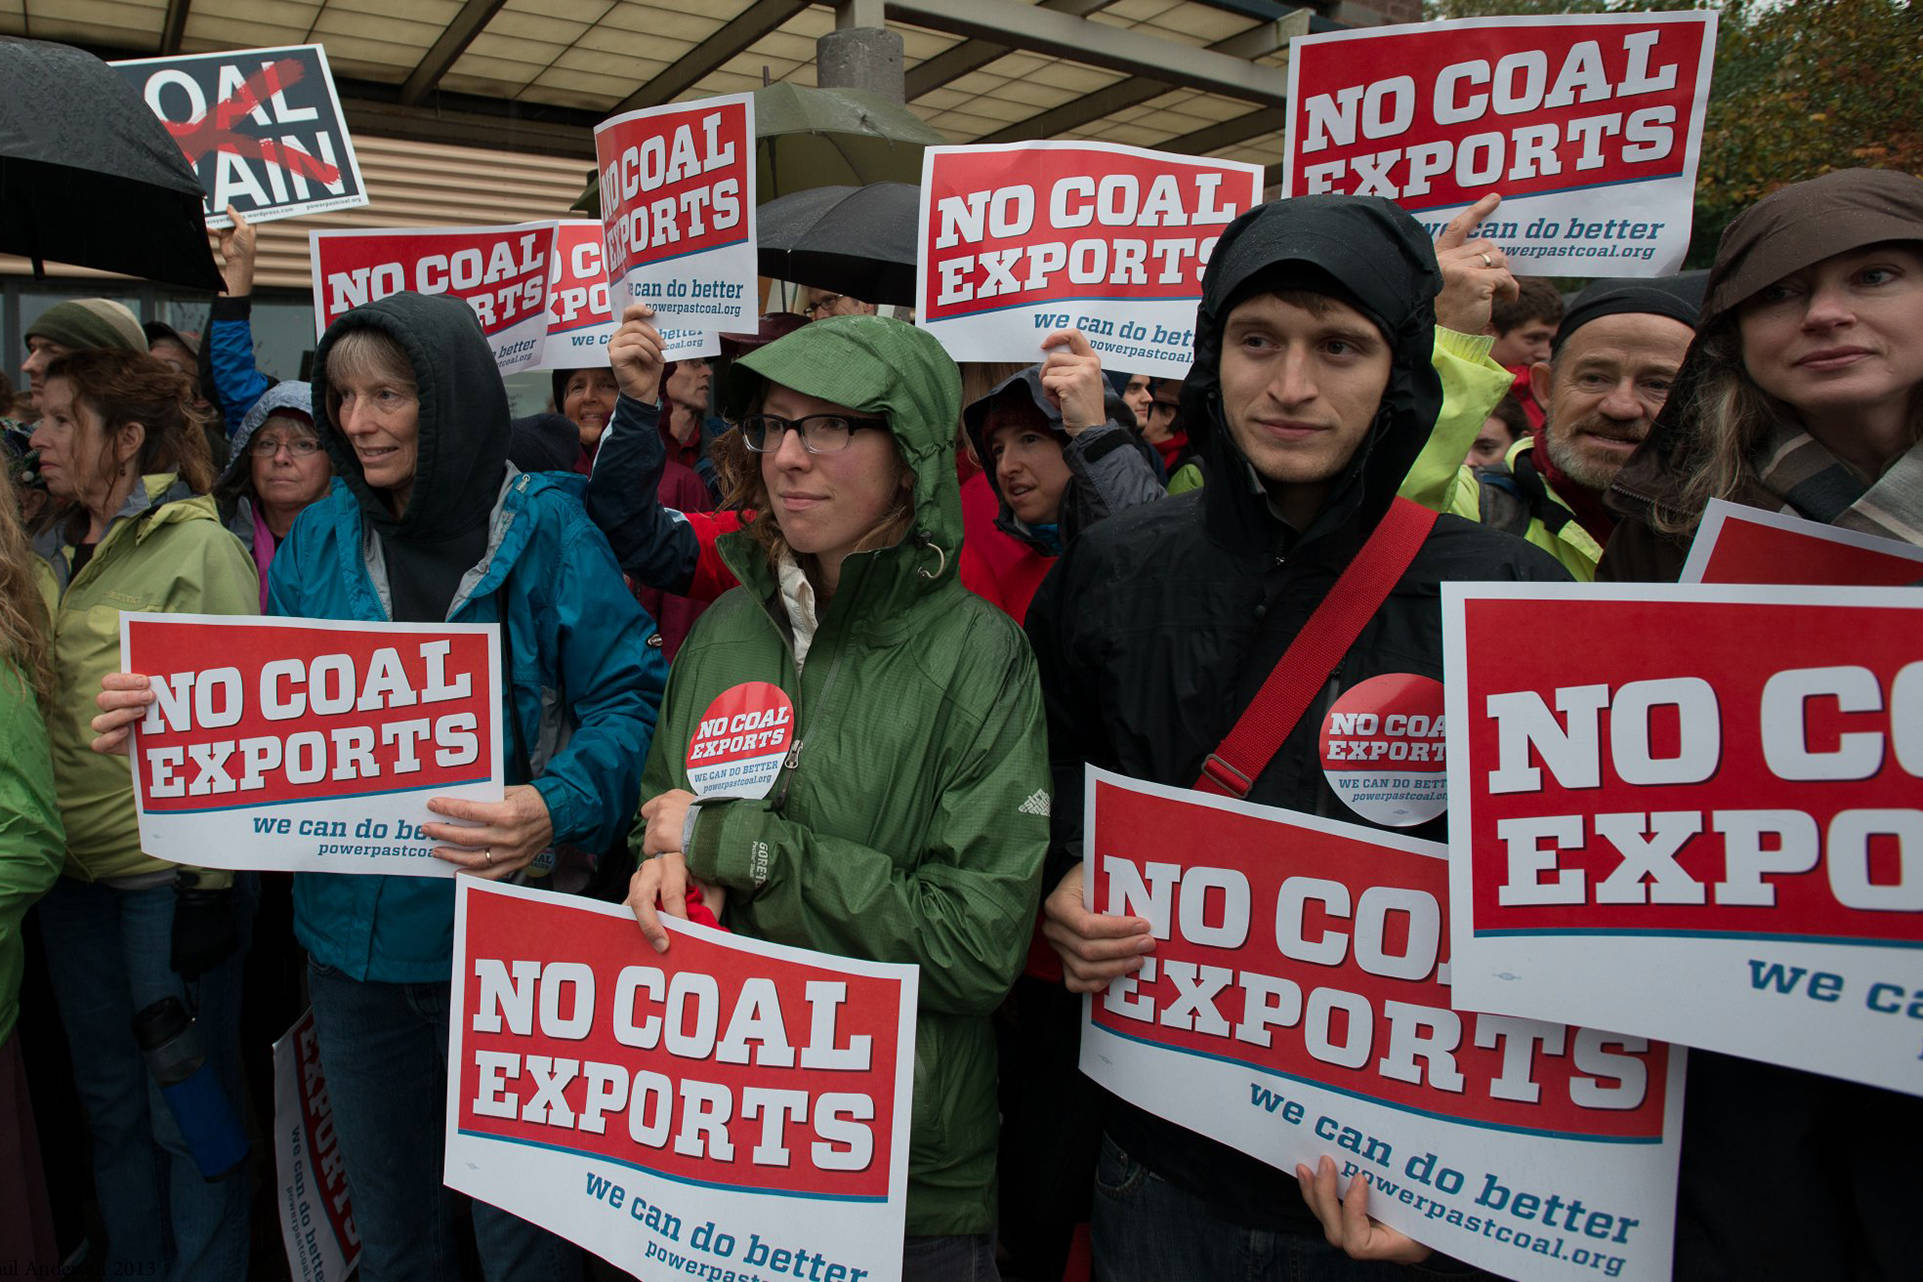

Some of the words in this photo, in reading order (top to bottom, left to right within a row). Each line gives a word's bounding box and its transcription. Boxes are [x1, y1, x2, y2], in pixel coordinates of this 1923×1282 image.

[144, 61, 319, 136] OAL
[1302, 75, 1416, 154] NO
[1433, 29, 1679, 125] COAL
[204, 131, 345, 214] AIN
[602, 159, 620, 222] NO
[622, 112, 735, 201] COAL
[1304, 105, 1677, 200] EXPORTS
[607, 178, 740, 272] EXPORTS
[936, 184, 1035, 250] NO
[1050, 173, 1237, 229] COAL
[1524, 218, 1559, 240] do
[1563, 218, 1664, 240] better
[328, 262, 405, 315] NO
[416, 234, 545, 296] COAL
[634, 282, 661, 298] can
[667, 279, 687, 299] do
[691, 280, 744, 299] better
[645, 302, 741, 317] powerpastcoal.org
[498, 339, 537, 359] better
[571, 334, 594, 346] we
[1034, 313, 1070, 329] we
[1076, 316, 1114, 336] can
[1119, 321, 1147, 341] do
[1151, 325, 1196, 348] bet
[1090, 340, 1194, 363] powerpastcoal.
[141, 666, 244, 735] NO
[259, 640, 473, 721] COAL
[697, 717, 729, 740] NO
[730, 706, 790, 733] COAL
[1329, 713, 1379, 735] NO
[1384, 714, 1446, 737] COA
[146, 712, 480, 799] EXPORTS
[690, 728, 785, 760] EXPORTS
[695, 773, 708, 782] WE
[709, 770, 727, 780] CAN
[729, 767, 740, 776] DO
[743, 760, 778, 773] BETTER
[1327, 740, 1447, 762] EXPORT
[1486, 677, 1722, 795] NO
[703, 774, 771, 793] powerpastcoal.org
[1339, 779, 1360, 789] WE
[1363, 779, 1388, 789] CAN
[1393, 779, 1409, 789] DO
[1414, 779, 1447, 789] BETT
[253, 817, 291, 834] we
[298, 819, 347, 838] can
[355, 819, 388, 839] do
[1498, 808, 1923, 912] EXPO
[1102, 855, 1251, 949] NO
[1275, 877, 1452, 985] CO
[472, 958, 595, 1040] NO
[612, 965, 873, 1072] COAL
[1748, 959, 1844, 1003] we
[1104, 955, 1648, 1110] EXPORTS
[472, 1050, 876, 1172] EXPORTS
[1250, 1082, 1305, 1126] we
[1314, 1115, 1393, 1169] can
[1404, 1152, 1465, 1195] do
[1474, 1173, 1640, 1245] better
[586, 1172, 625, 1209] we
[631, 1196, 681, 1242] can
[690, 1221, 736, 1258] do
